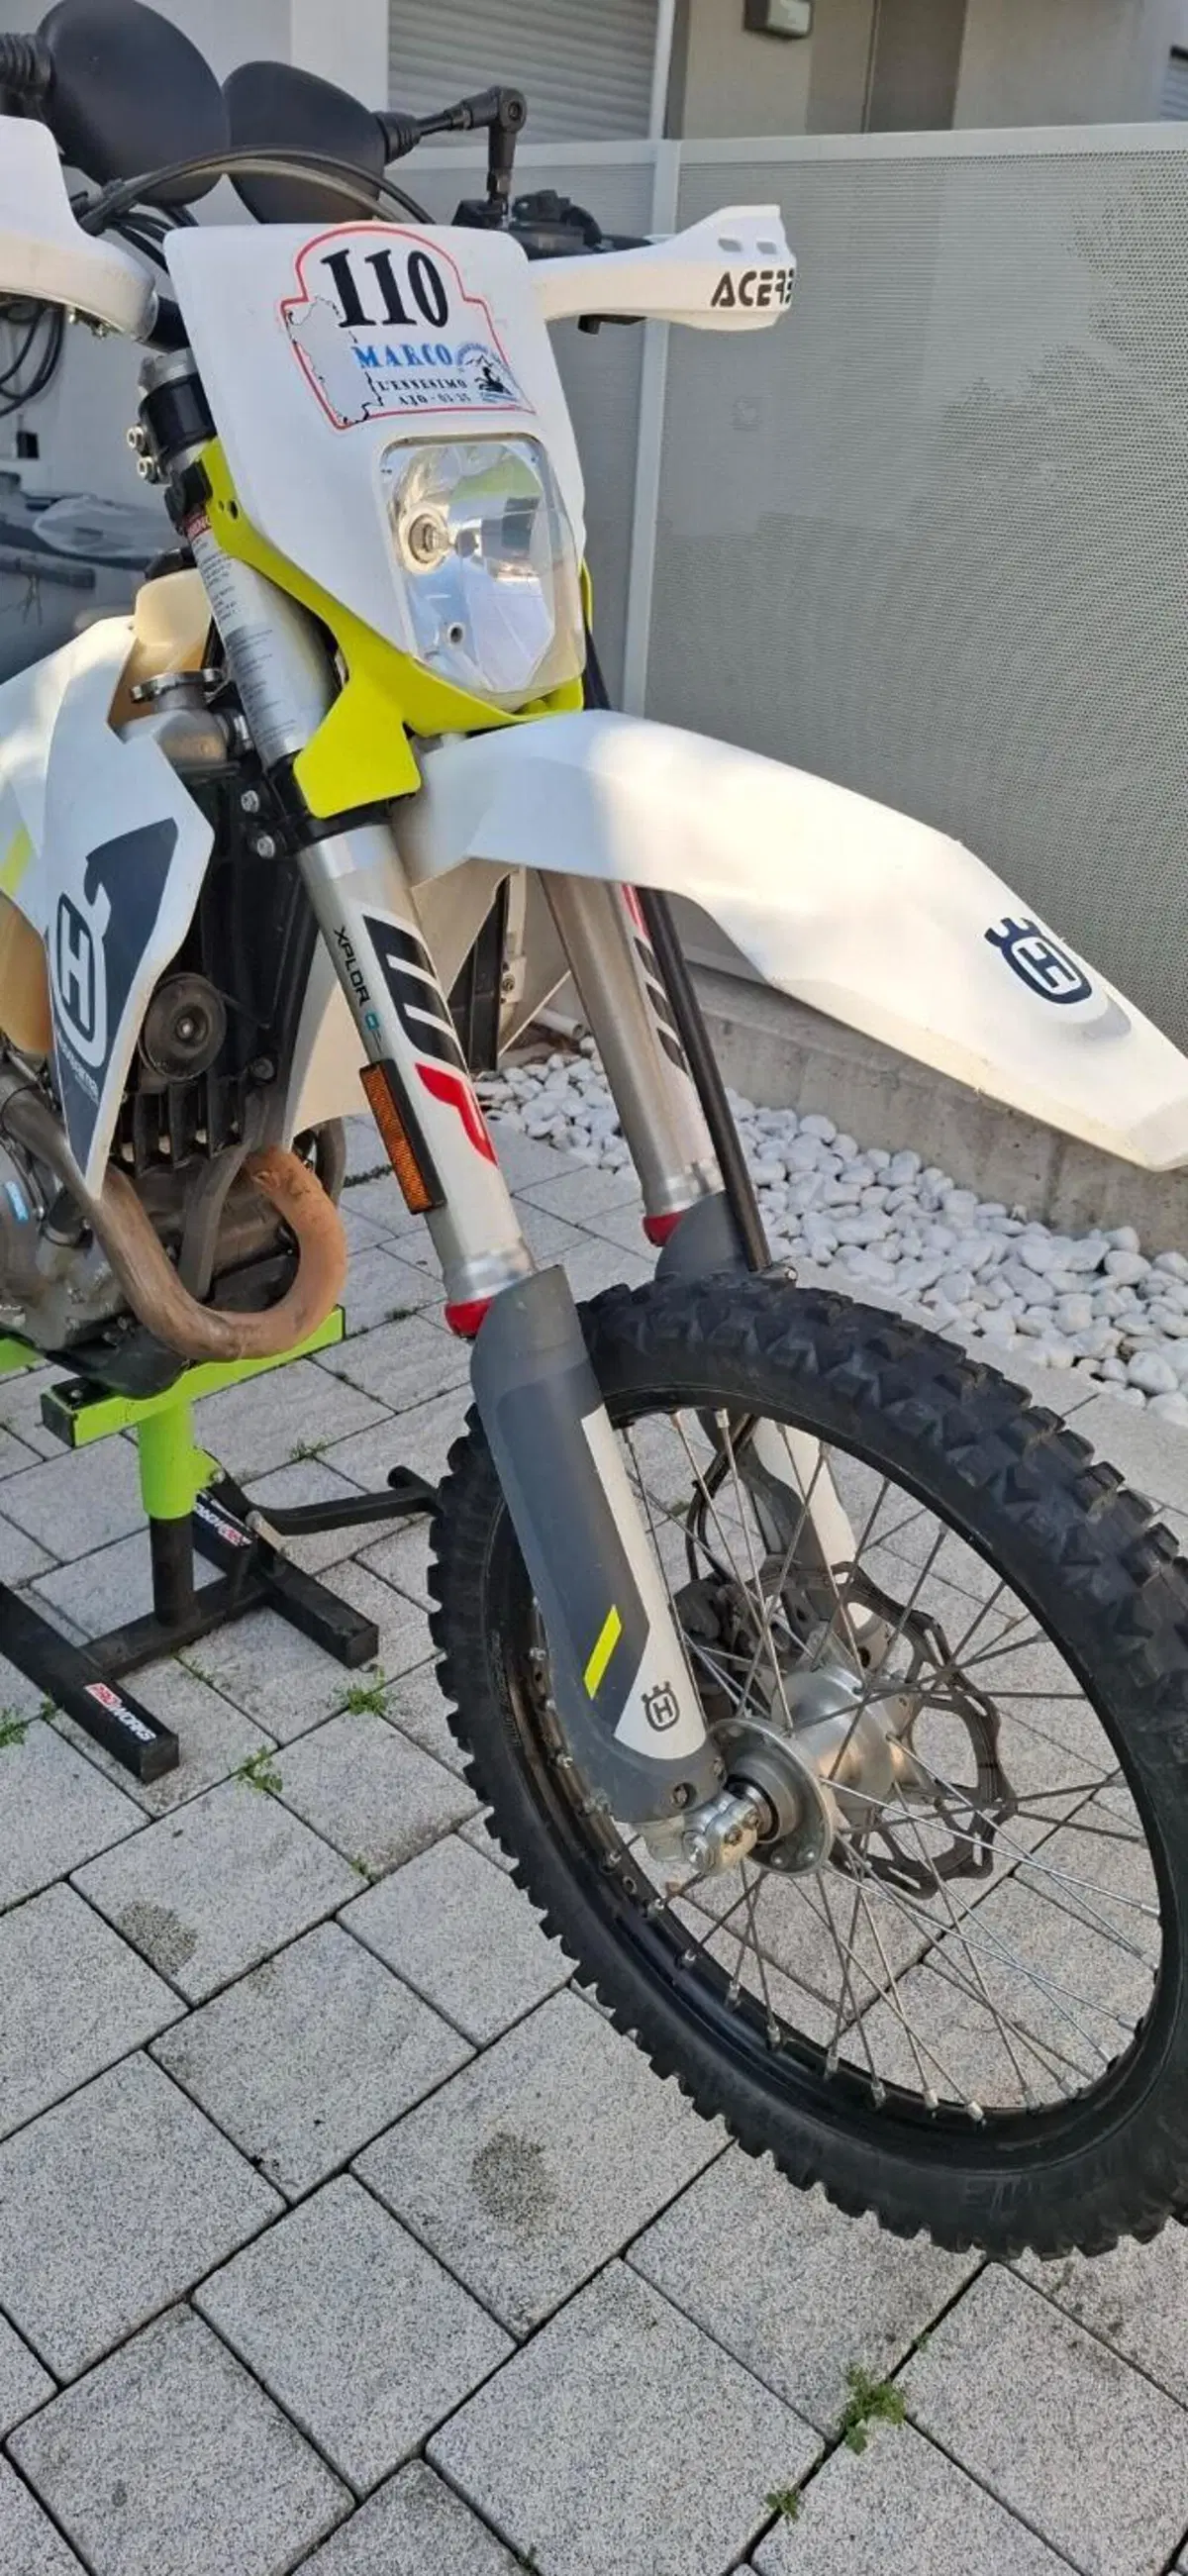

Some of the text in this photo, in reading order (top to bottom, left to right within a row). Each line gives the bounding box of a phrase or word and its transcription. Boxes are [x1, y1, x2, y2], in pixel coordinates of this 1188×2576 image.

[321, 249, 448, 328] 110
[350, 343, 452, 368] MARCO
[334, 926, 371, 1007] XPLOR
